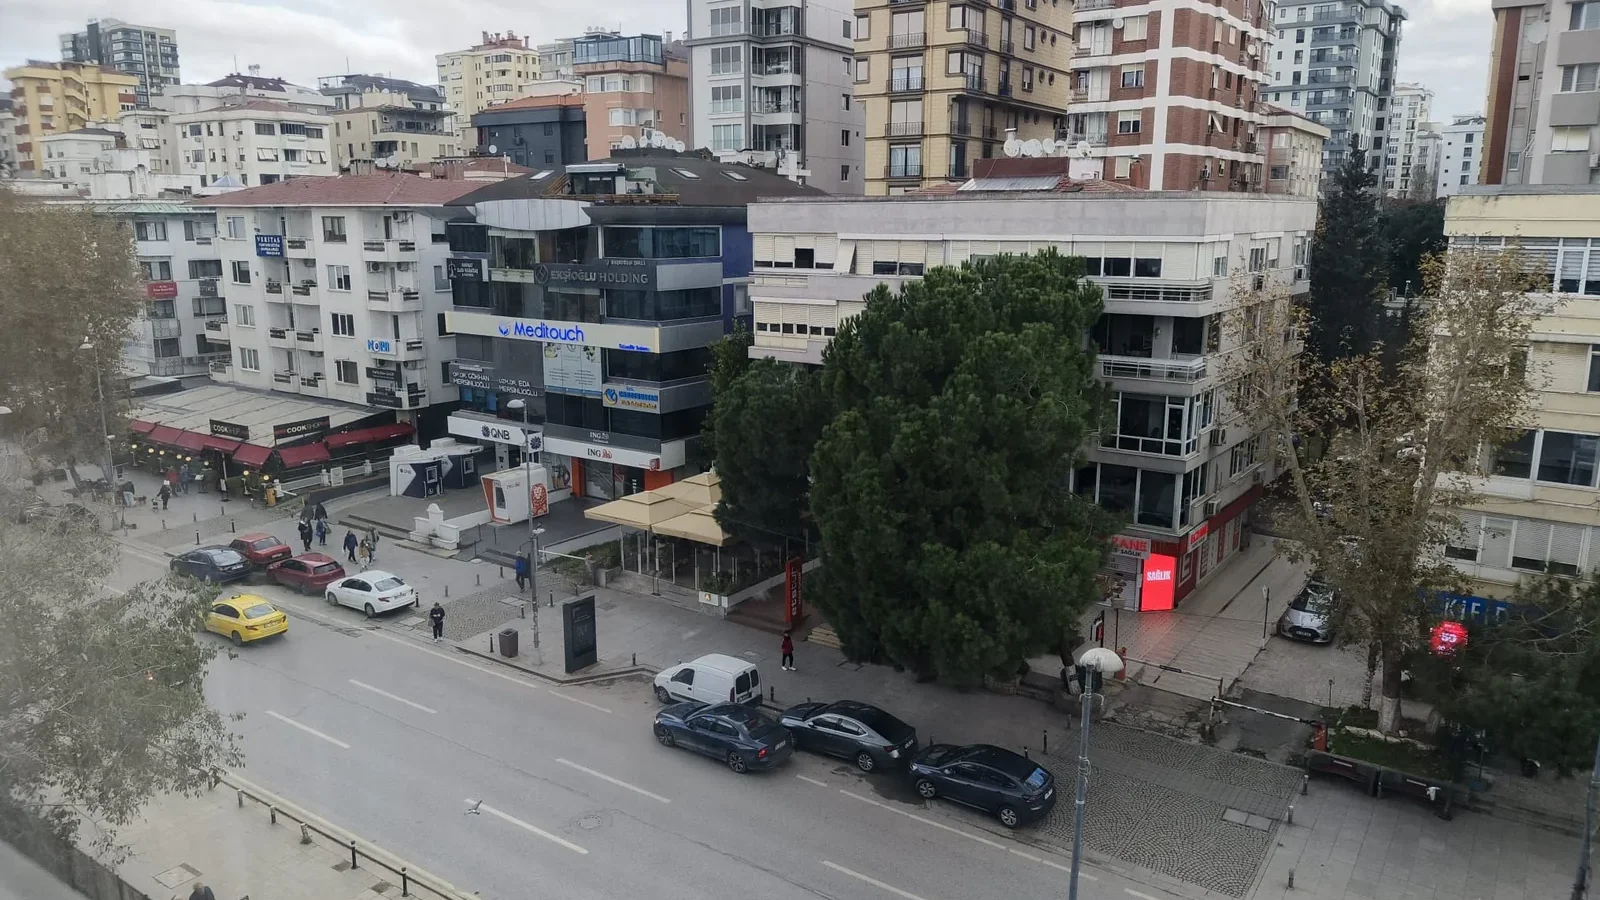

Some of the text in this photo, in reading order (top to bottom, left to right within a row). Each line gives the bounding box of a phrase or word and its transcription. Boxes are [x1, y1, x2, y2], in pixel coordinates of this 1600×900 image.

[513, 321, 585, 342] Meditouch
[518, 380, 531, 388] EDA
[490, 428, 510, 440] QNB
[587, 448, 601, 457] ING
[1120, 549, 1142, 557] SAĞLIK
[1146, 569, 1172, 581] SAĞLIK
